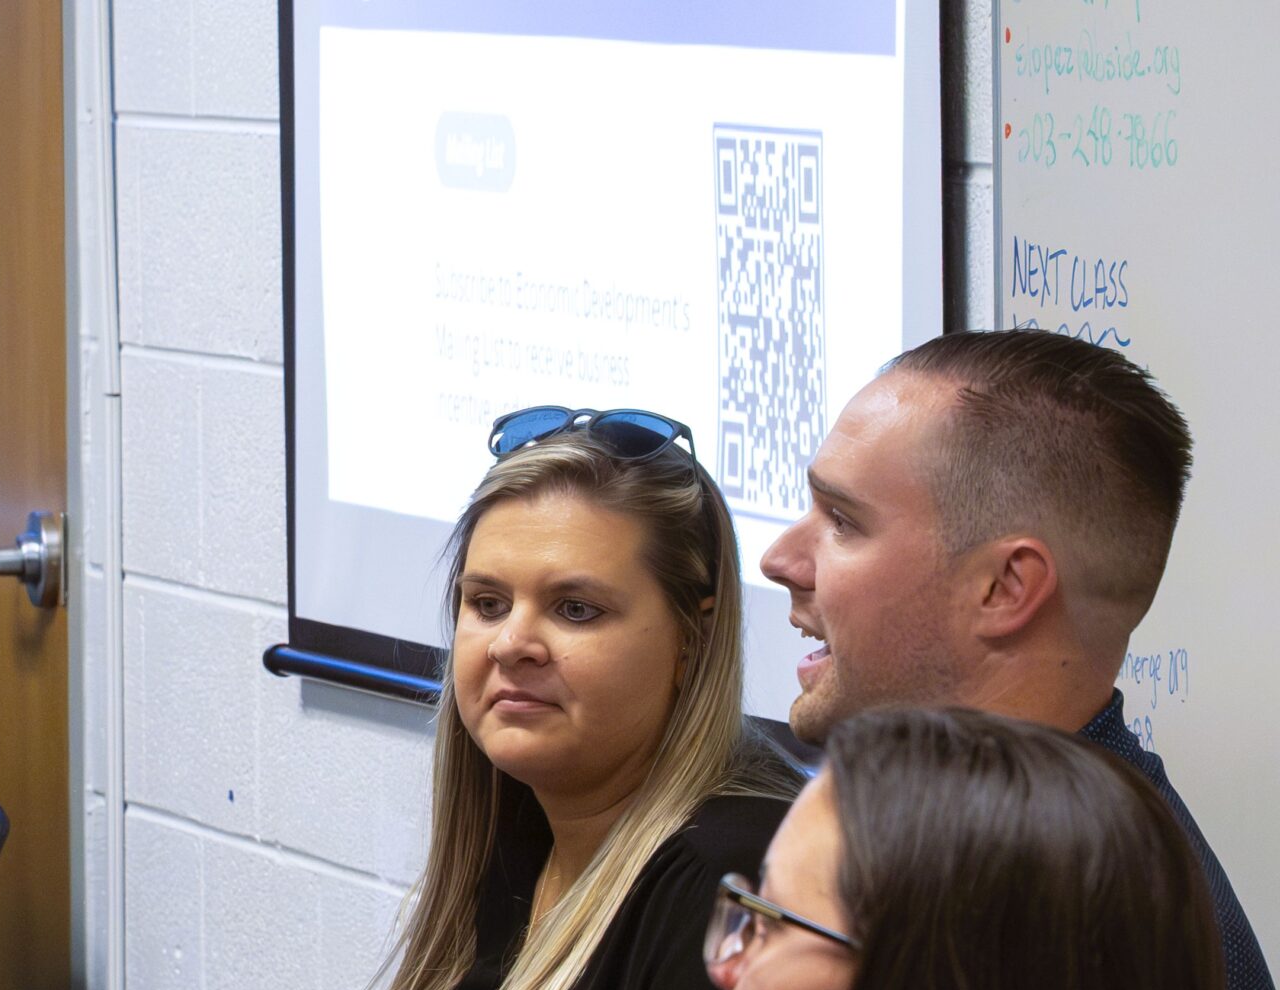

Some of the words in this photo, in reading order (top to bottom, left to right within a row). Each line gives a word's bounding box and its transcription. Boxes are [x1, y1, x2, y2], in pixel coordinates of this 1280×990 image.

[516, 271, 581, 317] Economic
[583, 278, 691, 334] Development's
[1012, 235, 1067, 307] NEXT
[1070, 256, 1129, 312] CLASS
[525, 341, 573, 378] receive
[577, 341, 630, 387] business
